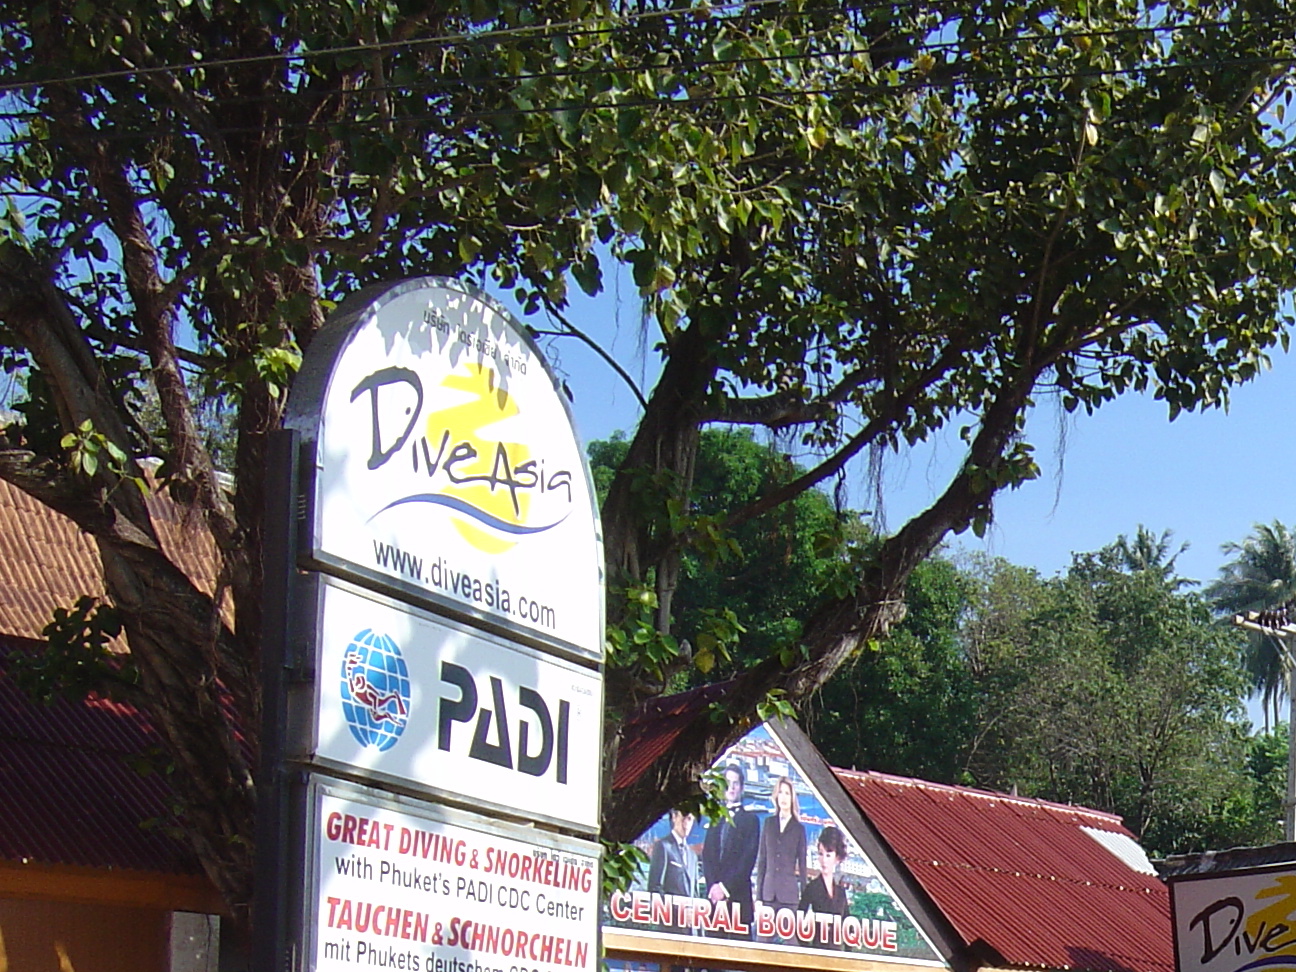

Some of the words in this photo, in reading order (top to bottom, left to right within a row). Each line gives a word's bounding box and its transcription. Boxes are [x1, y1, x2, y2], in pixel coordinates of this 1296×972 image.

[373, 538, 556, 630] www.diveasia.com
[437, 660, 570, 785] PADI
[326, 811, 394, 851] GREAT
[398, 828, 466, 867] DIVING
[469, 848, 479, 870] &
[484, 846, 592, 893] SNORKELING
[335, 855, 373, 880] with
[380, 863, 450, 896] Phuket's
[457, 877, 493, 904] PADI
[497, 885, 530, 911] CDC
[536, 893, 584, 922] Center
[610, 891, 749, 933] CENTRAL
[756, 905, 898, 951] BOUTIQUE
[324, 938, 350, 962] mit
[356, 941, 420, 972] Phukets
[327, 896, 429, 943] TAUCHEN
[432, 922, 443, 946] &
[446, 916, 588, 968] SCHNORCHELN
